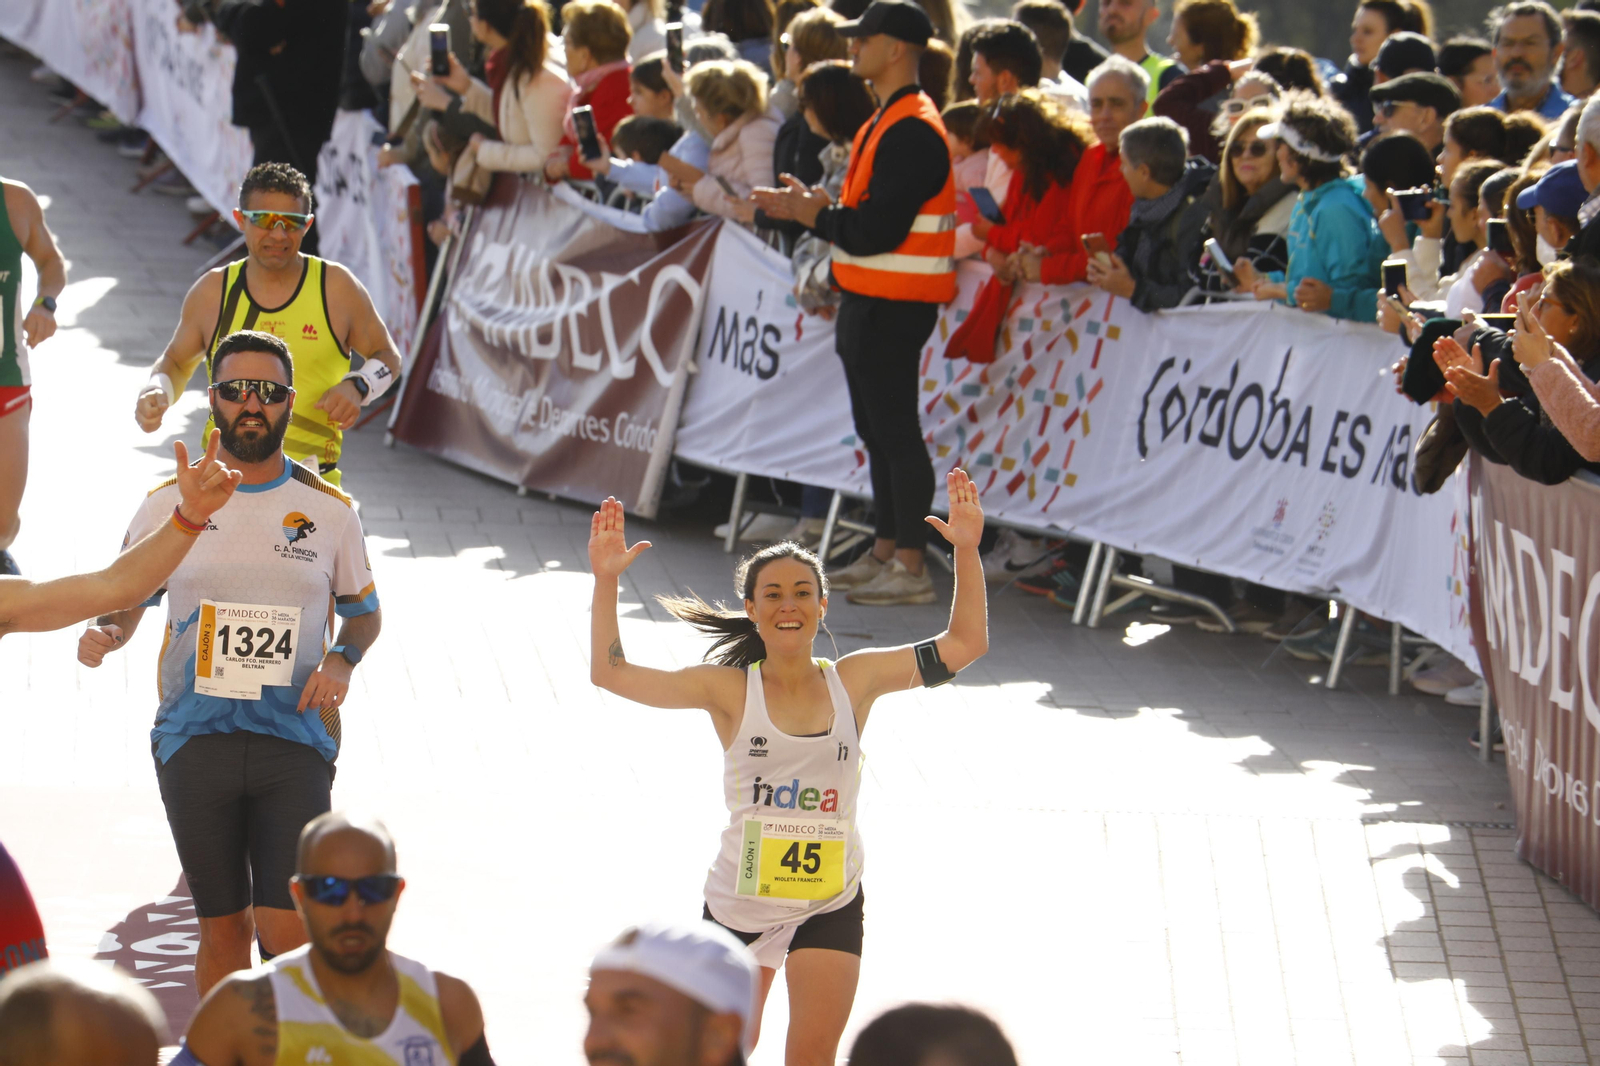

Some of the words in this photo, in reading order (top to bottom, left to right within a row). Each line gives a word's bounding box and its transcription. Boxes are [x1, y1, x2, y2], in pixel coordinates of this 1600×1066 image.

[1320, 409, 1371, 479] ES
[292, 547, 318, 558] RINCÓN
[228, 609, 269, 619] IMDECO
[202, 630, 211, 661] CAJÓN
[218, 625, 292, 660] 1324
[753, 776, 839, 812] indea
[774, 824, 816, 834] IMDECO
[745, 848, 755, 879] CAJÓN
[780, 842, 821, 874] 45
